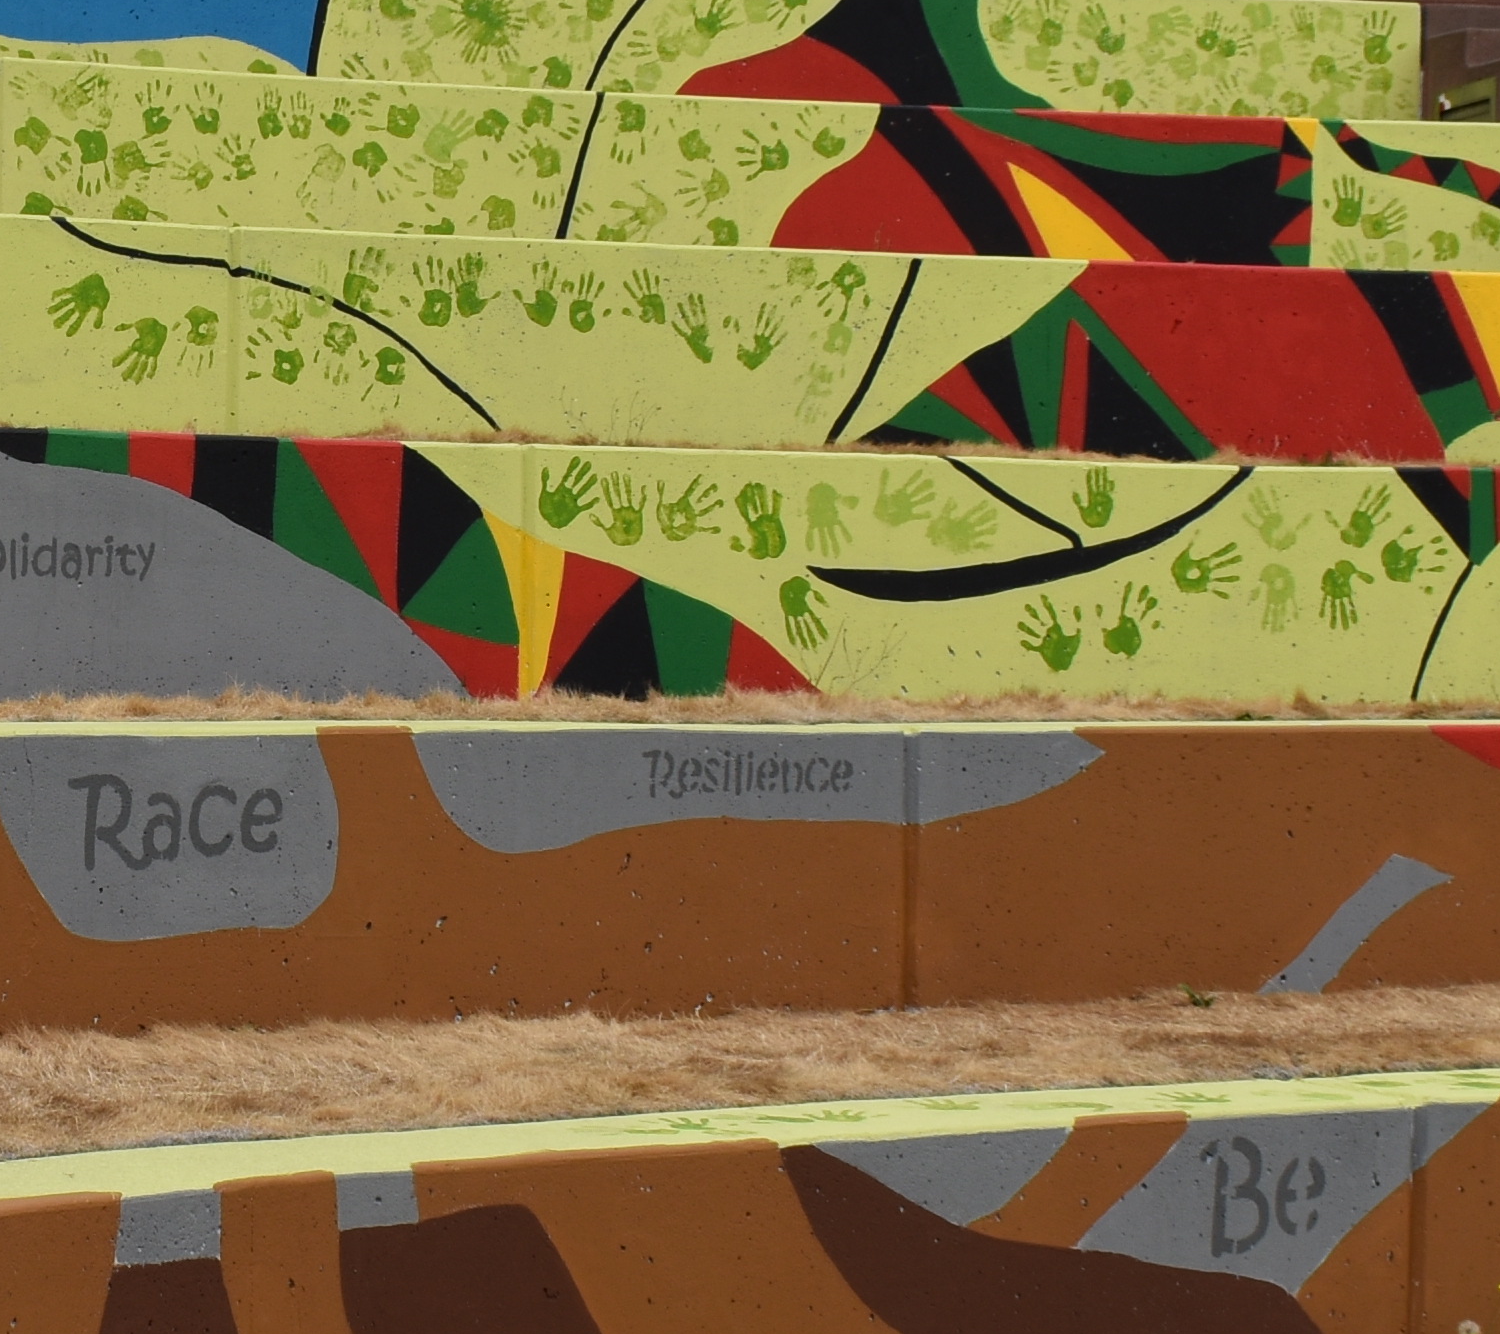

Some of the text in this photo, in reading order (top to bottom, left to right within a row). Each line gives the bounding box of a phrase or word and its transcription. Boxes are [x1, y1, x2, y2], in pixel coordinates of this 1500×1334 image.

[67, 773, 283, 872] Race
[641, 749, 854, 800] Resilience
[1200, 1135, 1326, 1258] Be
